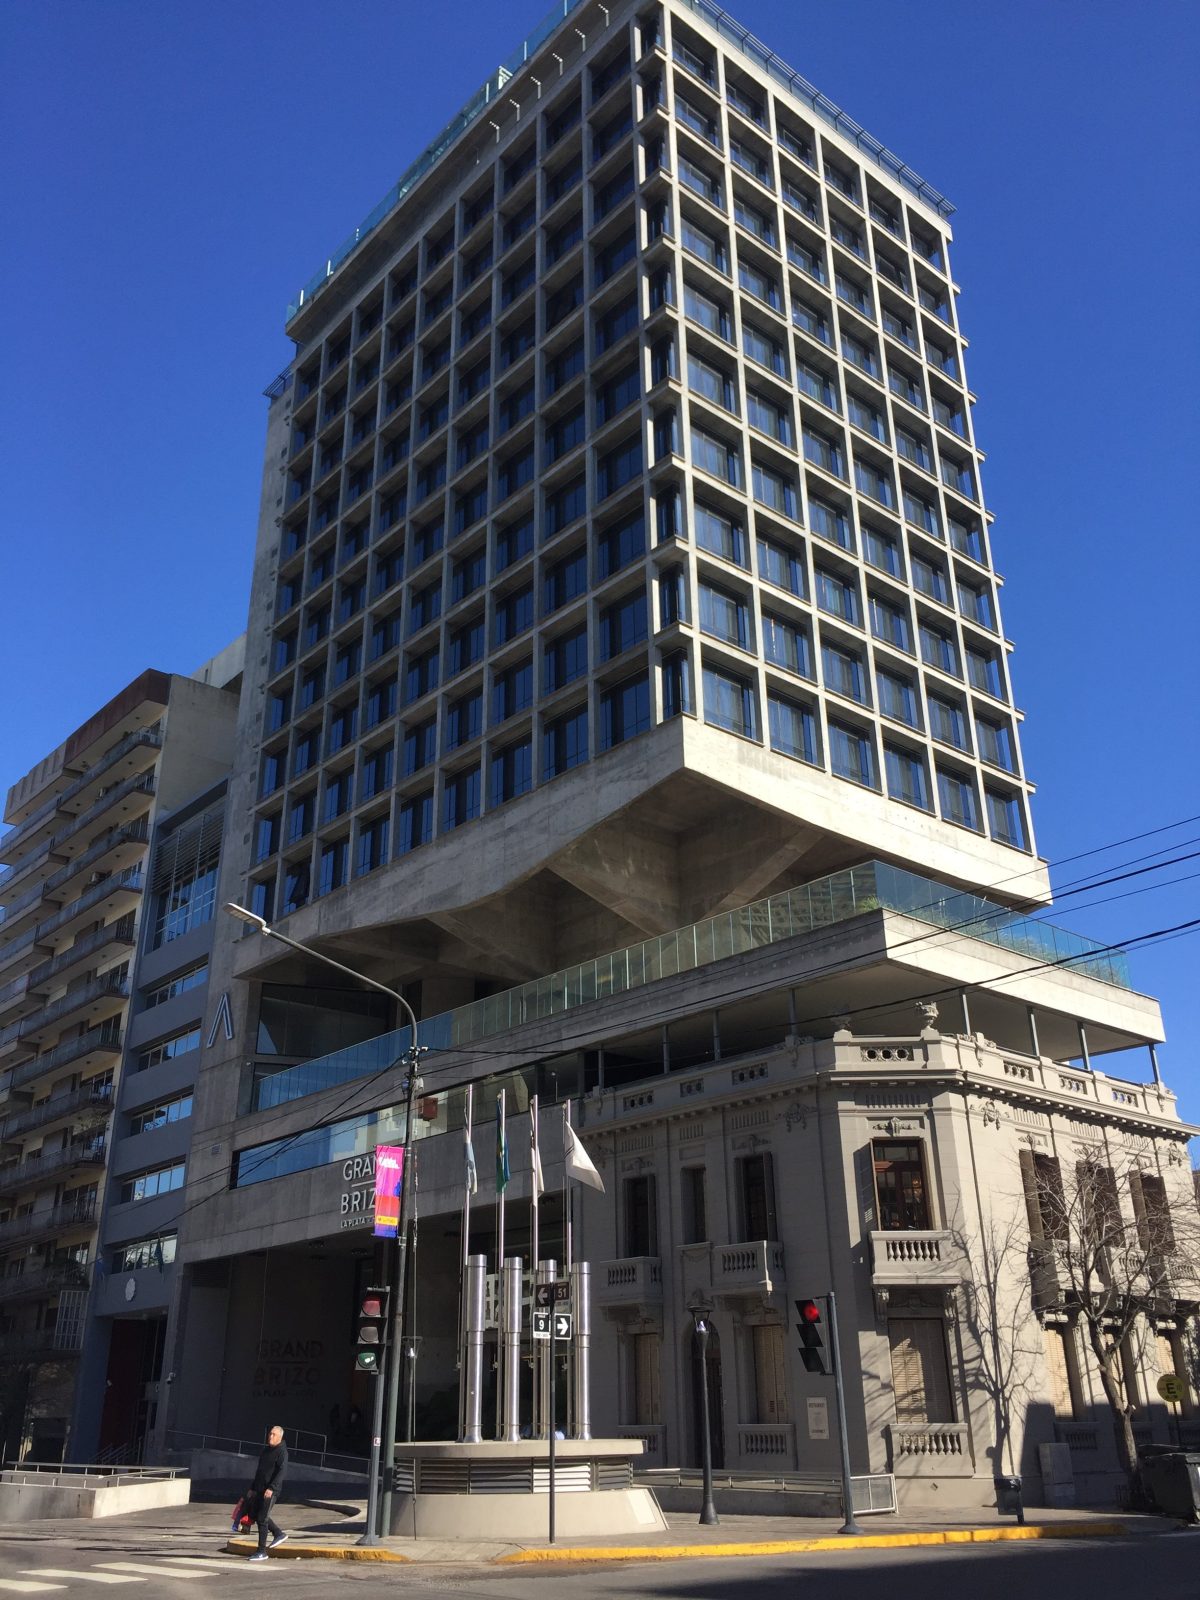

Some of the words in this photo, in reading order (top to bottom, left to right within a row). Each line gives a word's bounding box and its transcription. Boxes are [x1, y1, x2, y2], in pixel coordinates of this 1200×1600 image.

[341, 1219, 348, 1229] LA
[348, 1217, 366, 1227] PLATA
[558, 1288, 567, 1298] 51
[539, 1319, 545, 1330] 9
[256, 1339, 324, 1358] GRAND
[255, 1367, 321, 1385] BRIZO
[1166, 1382, 1177, 1394] E
